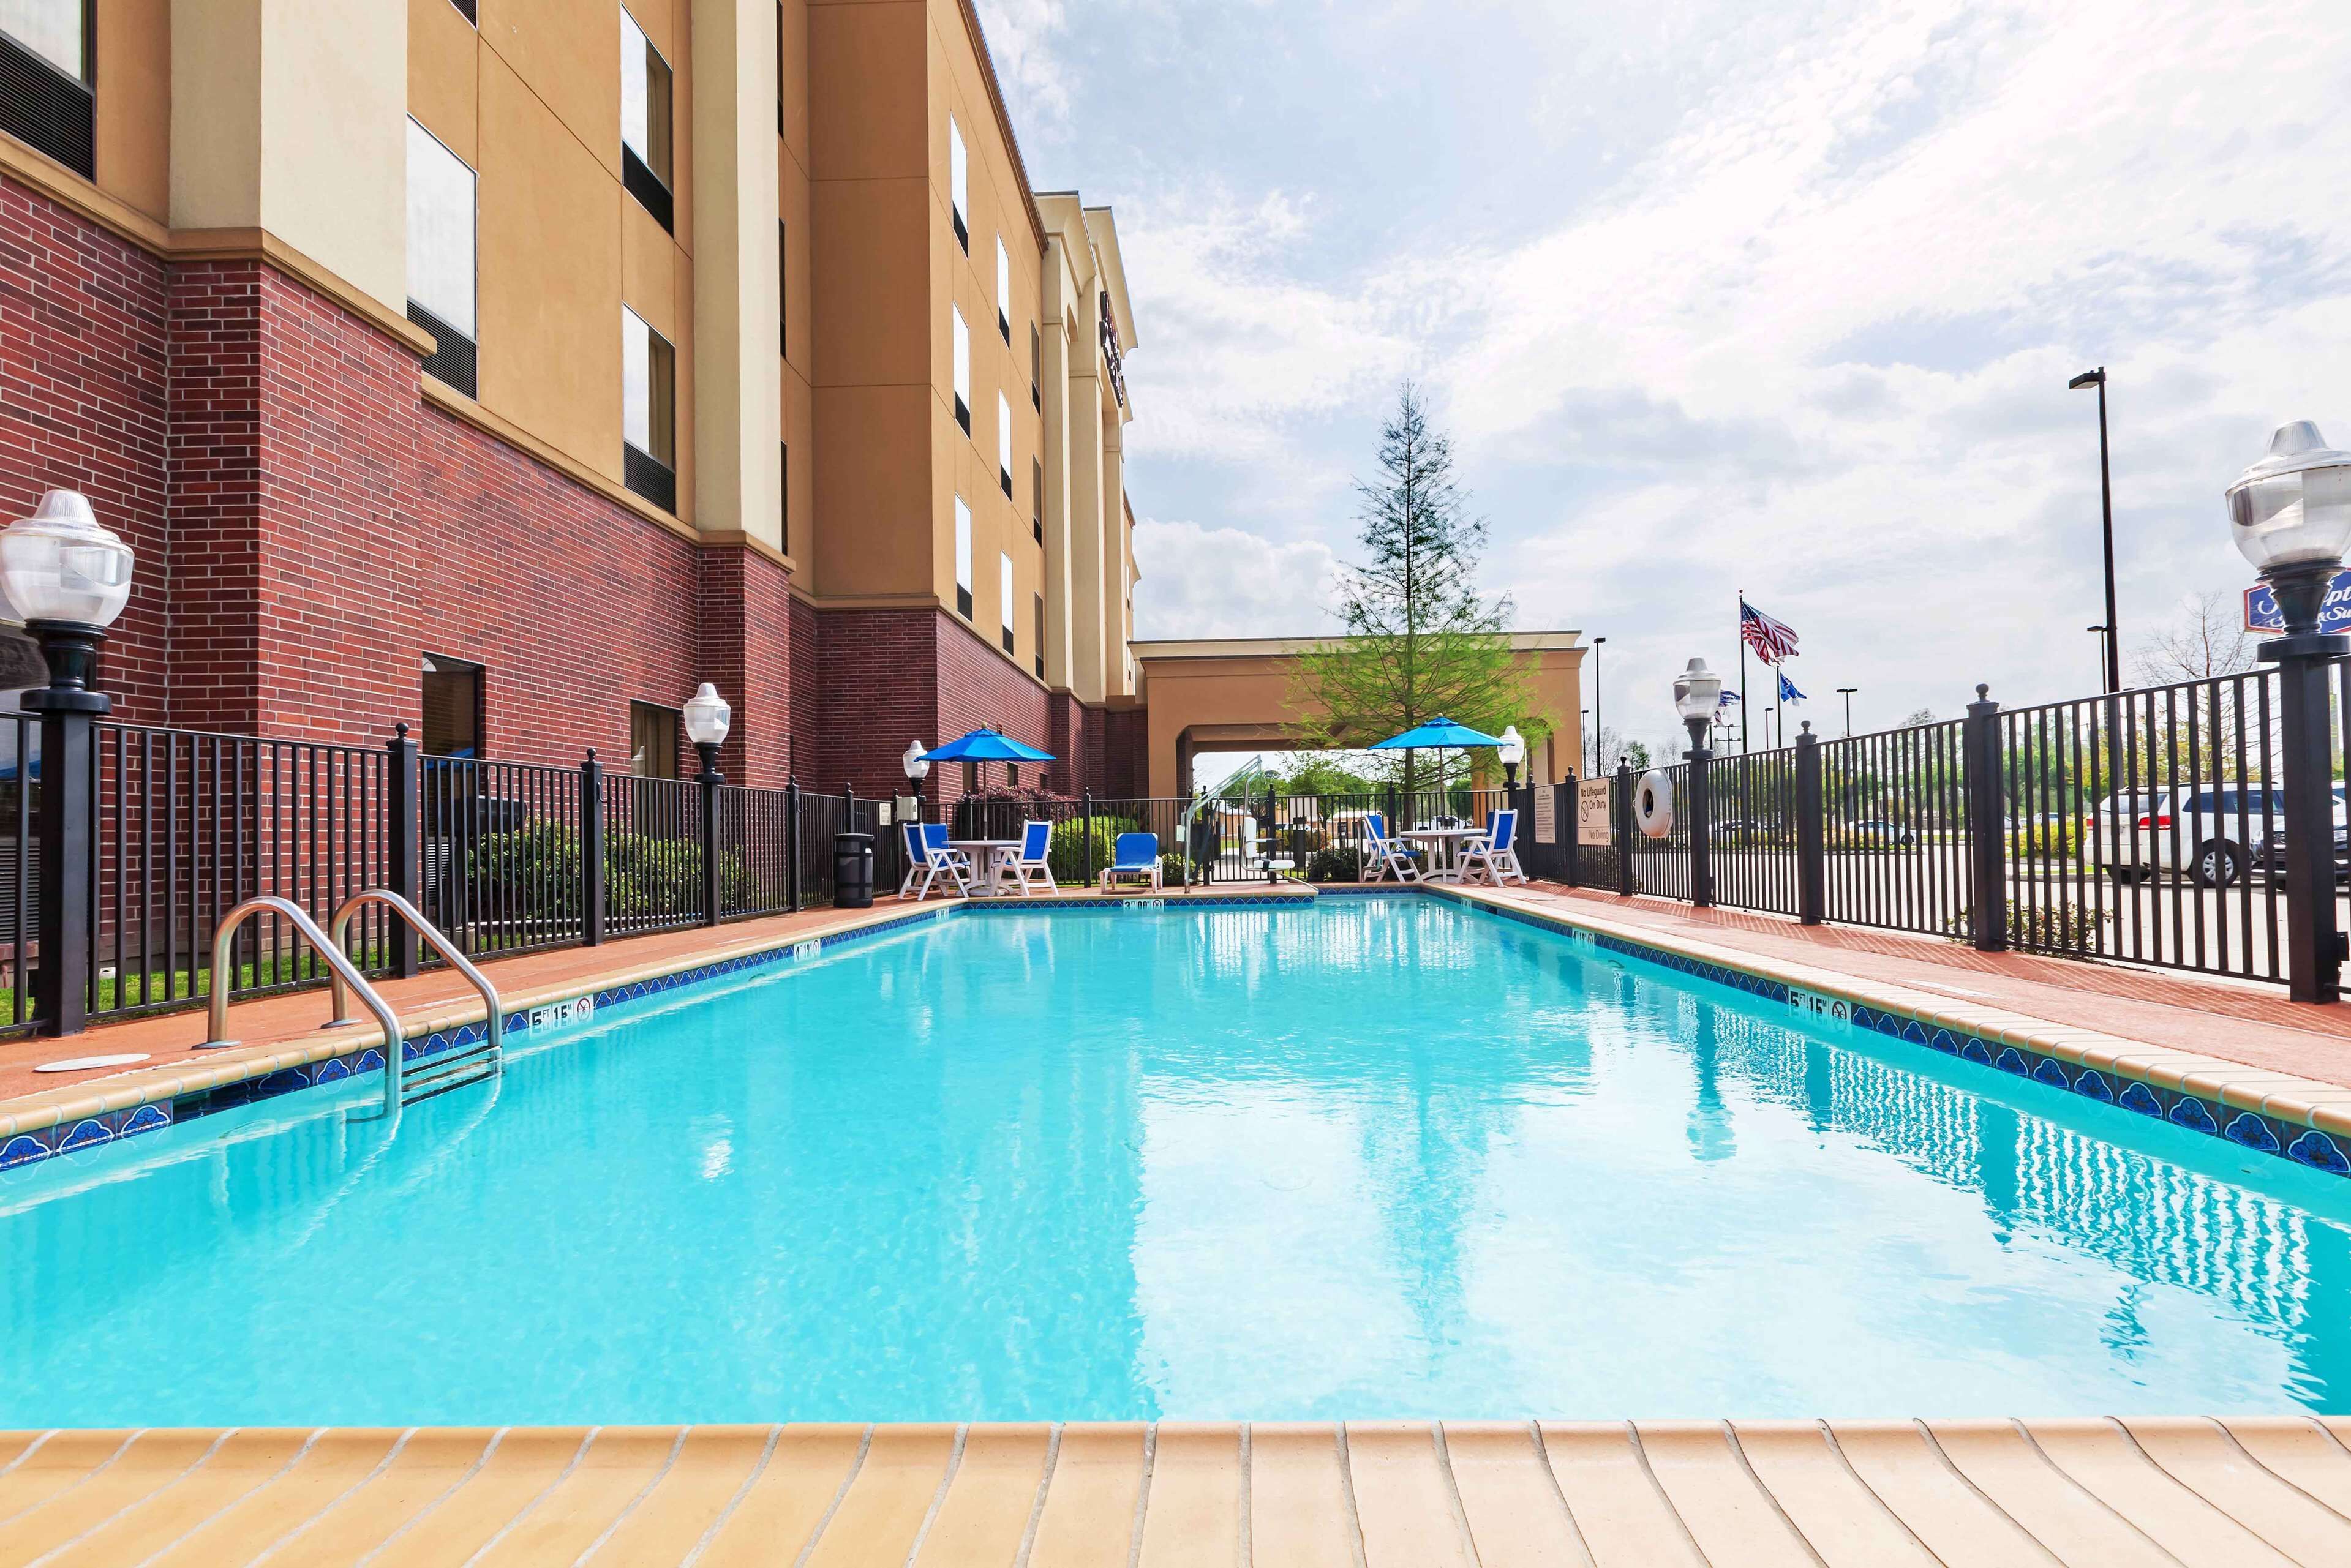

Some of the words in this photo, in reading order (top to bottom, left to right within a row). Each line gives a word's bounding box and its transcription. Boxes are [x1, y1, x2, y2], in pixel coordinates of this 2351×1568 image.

[1581, 788, 1586, 797] No
[1587, 785, 1606, 798] Lifeguard
[1590, 800, 1595, 809] On
[1597, 800, 1606, 811] Duty
[1589, 830, 1595, 839] No
[1596, 828, 1609, 842] Diving
